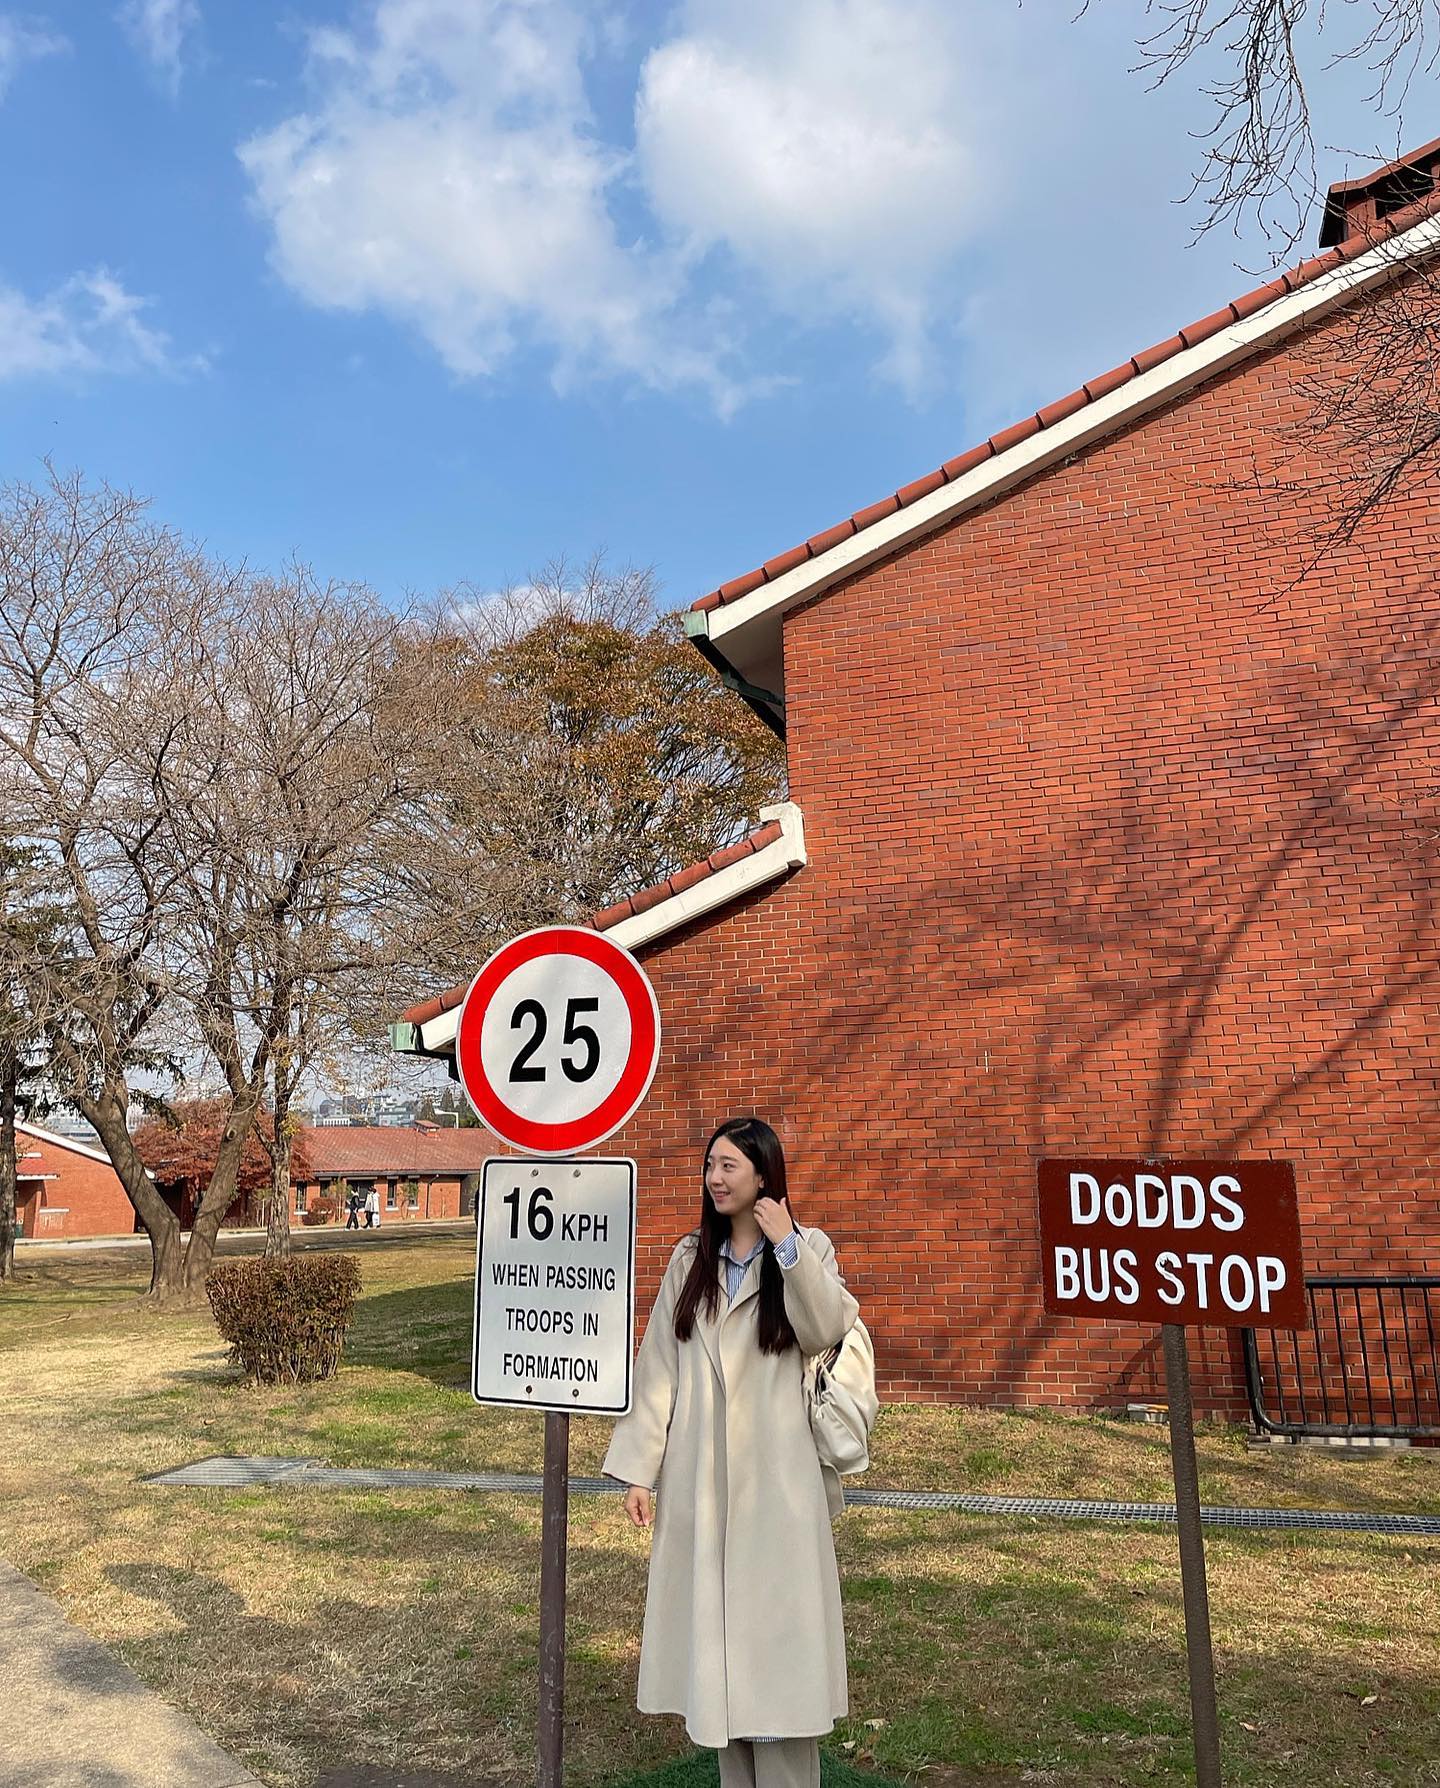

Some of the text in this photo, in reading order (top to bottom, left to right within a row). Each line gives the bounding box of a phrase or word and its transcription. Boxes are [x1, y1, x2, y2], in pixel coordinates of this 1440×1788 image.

[508, 997, 600, 1083] 25
[503, 1187, 608, 1242] 16 KPH
[1069, 1172, 1245, 1231] DoDDS
[492, 1263, 616, 1291] WHEN PASSING
[1054, 1246, 1287, 1313] BUS STOP
[506, 1308, 599, 1336] TROOPS IN
[503, 1354, 599, 1382] FORMATION
